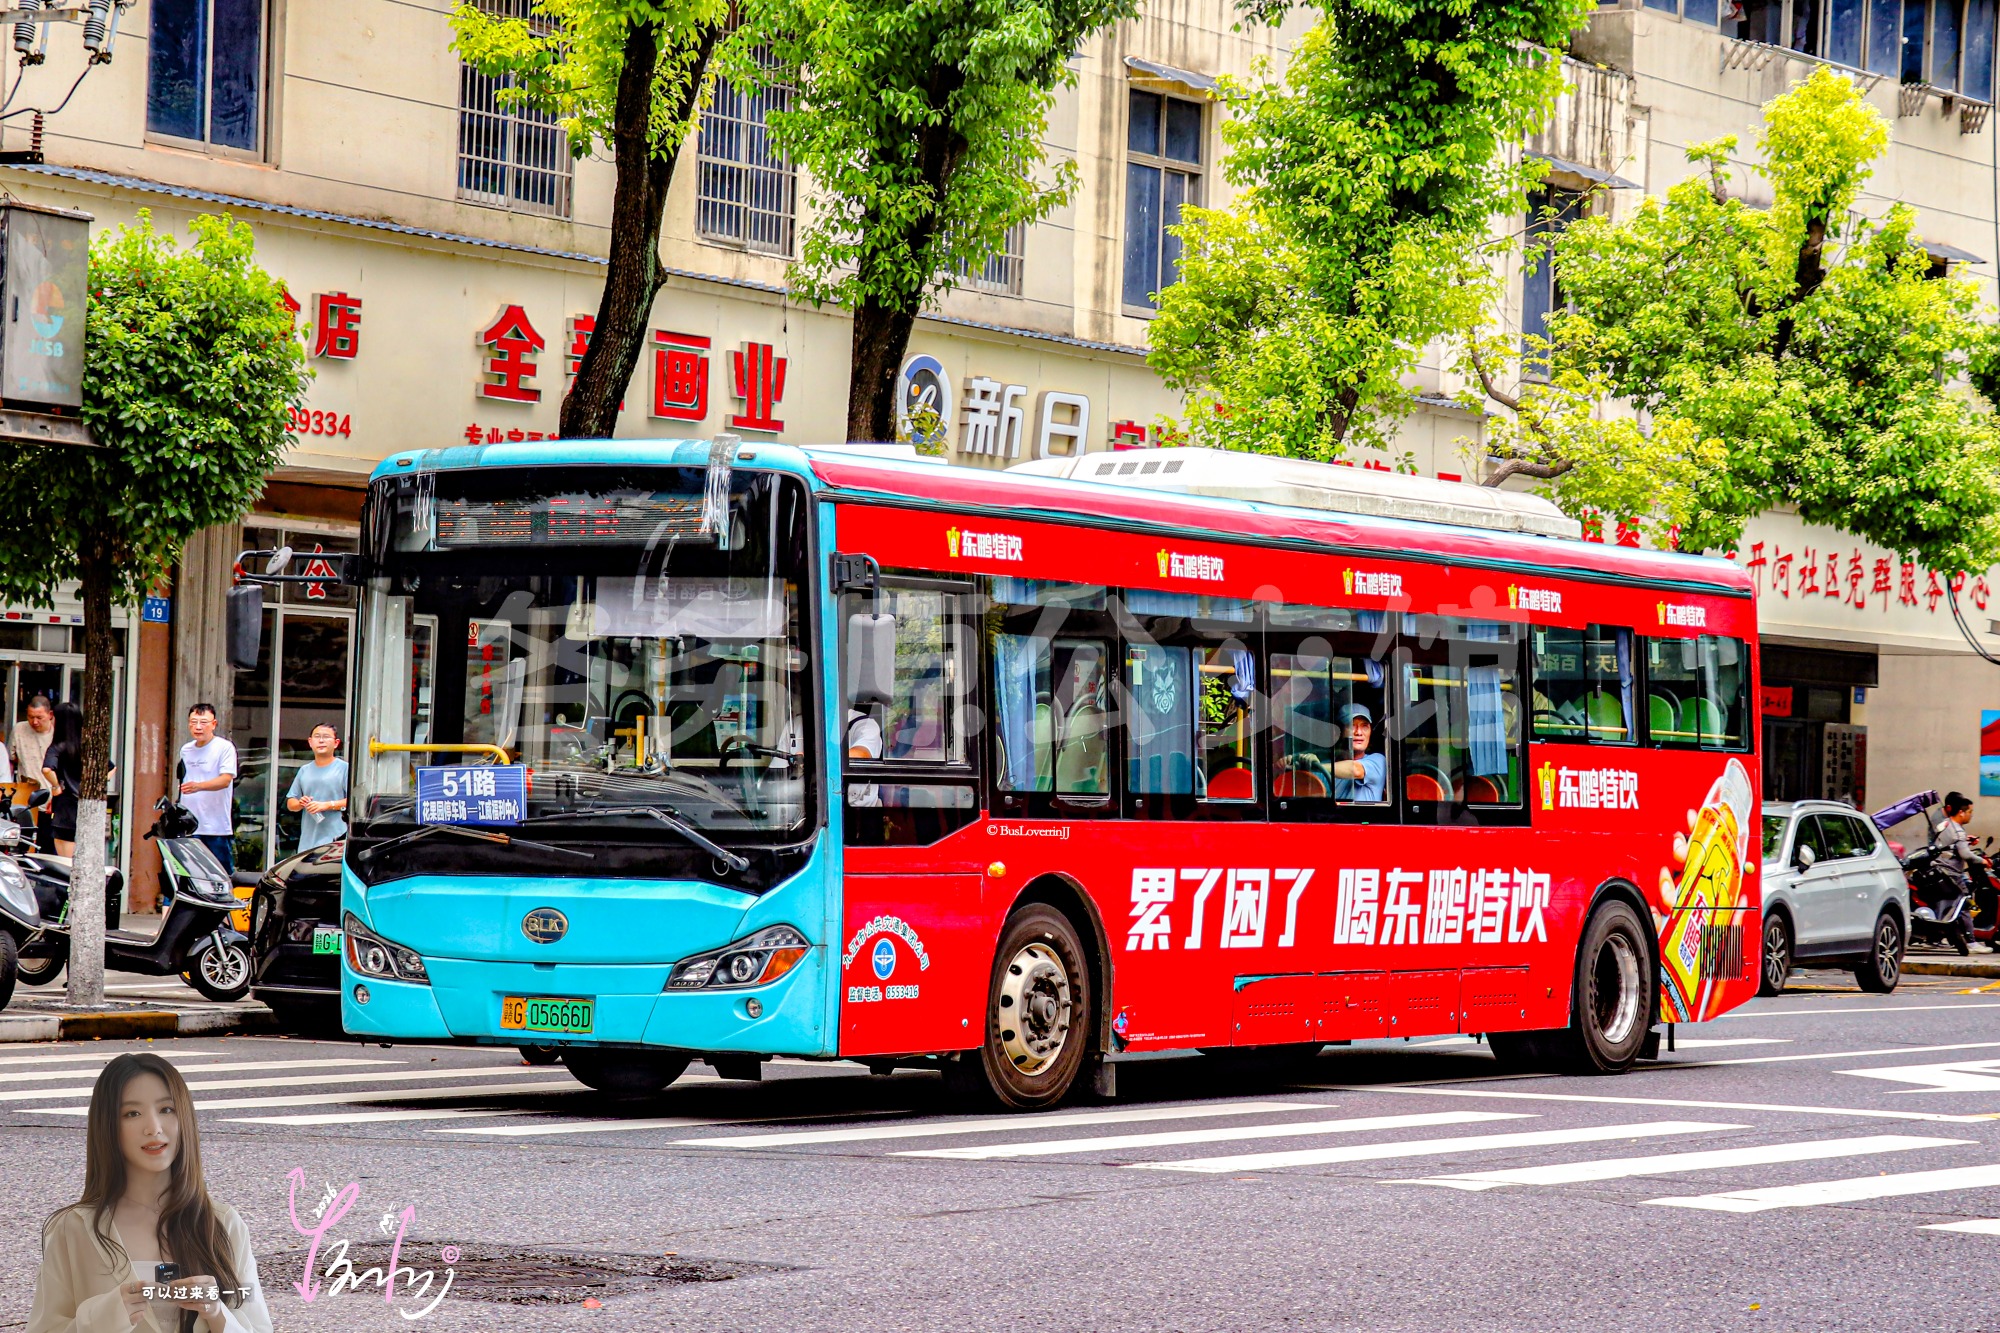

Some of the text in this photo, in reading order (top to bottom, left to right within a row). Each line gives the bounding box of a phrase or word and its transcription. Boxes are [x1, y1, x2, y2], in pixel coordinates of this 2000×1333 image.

[960, 376, 1091, 459] 新日
[961, 530, 1024, 561] 东鹏特饮
[1170, 552, 1225, 581] 东鹏特饮
[1725, 541, 1991, 616] 开河社区党群服务中心
[1354, 570, 1403, 596] 东鹏特饮
[151, 607, 163, 619] 19
[1518, 587, 1562, 613] 东鹏特饮
[1665, 603, 1706, 627] 东鹏特饮
[443, 769, 496, 797] 51路
[1558, 766, 1640, 810] 东鹏特饮
[1125, 866, 1552, 951] 累了困了 喝东鹏特饮
[528, 917, 560, 932] BLK
